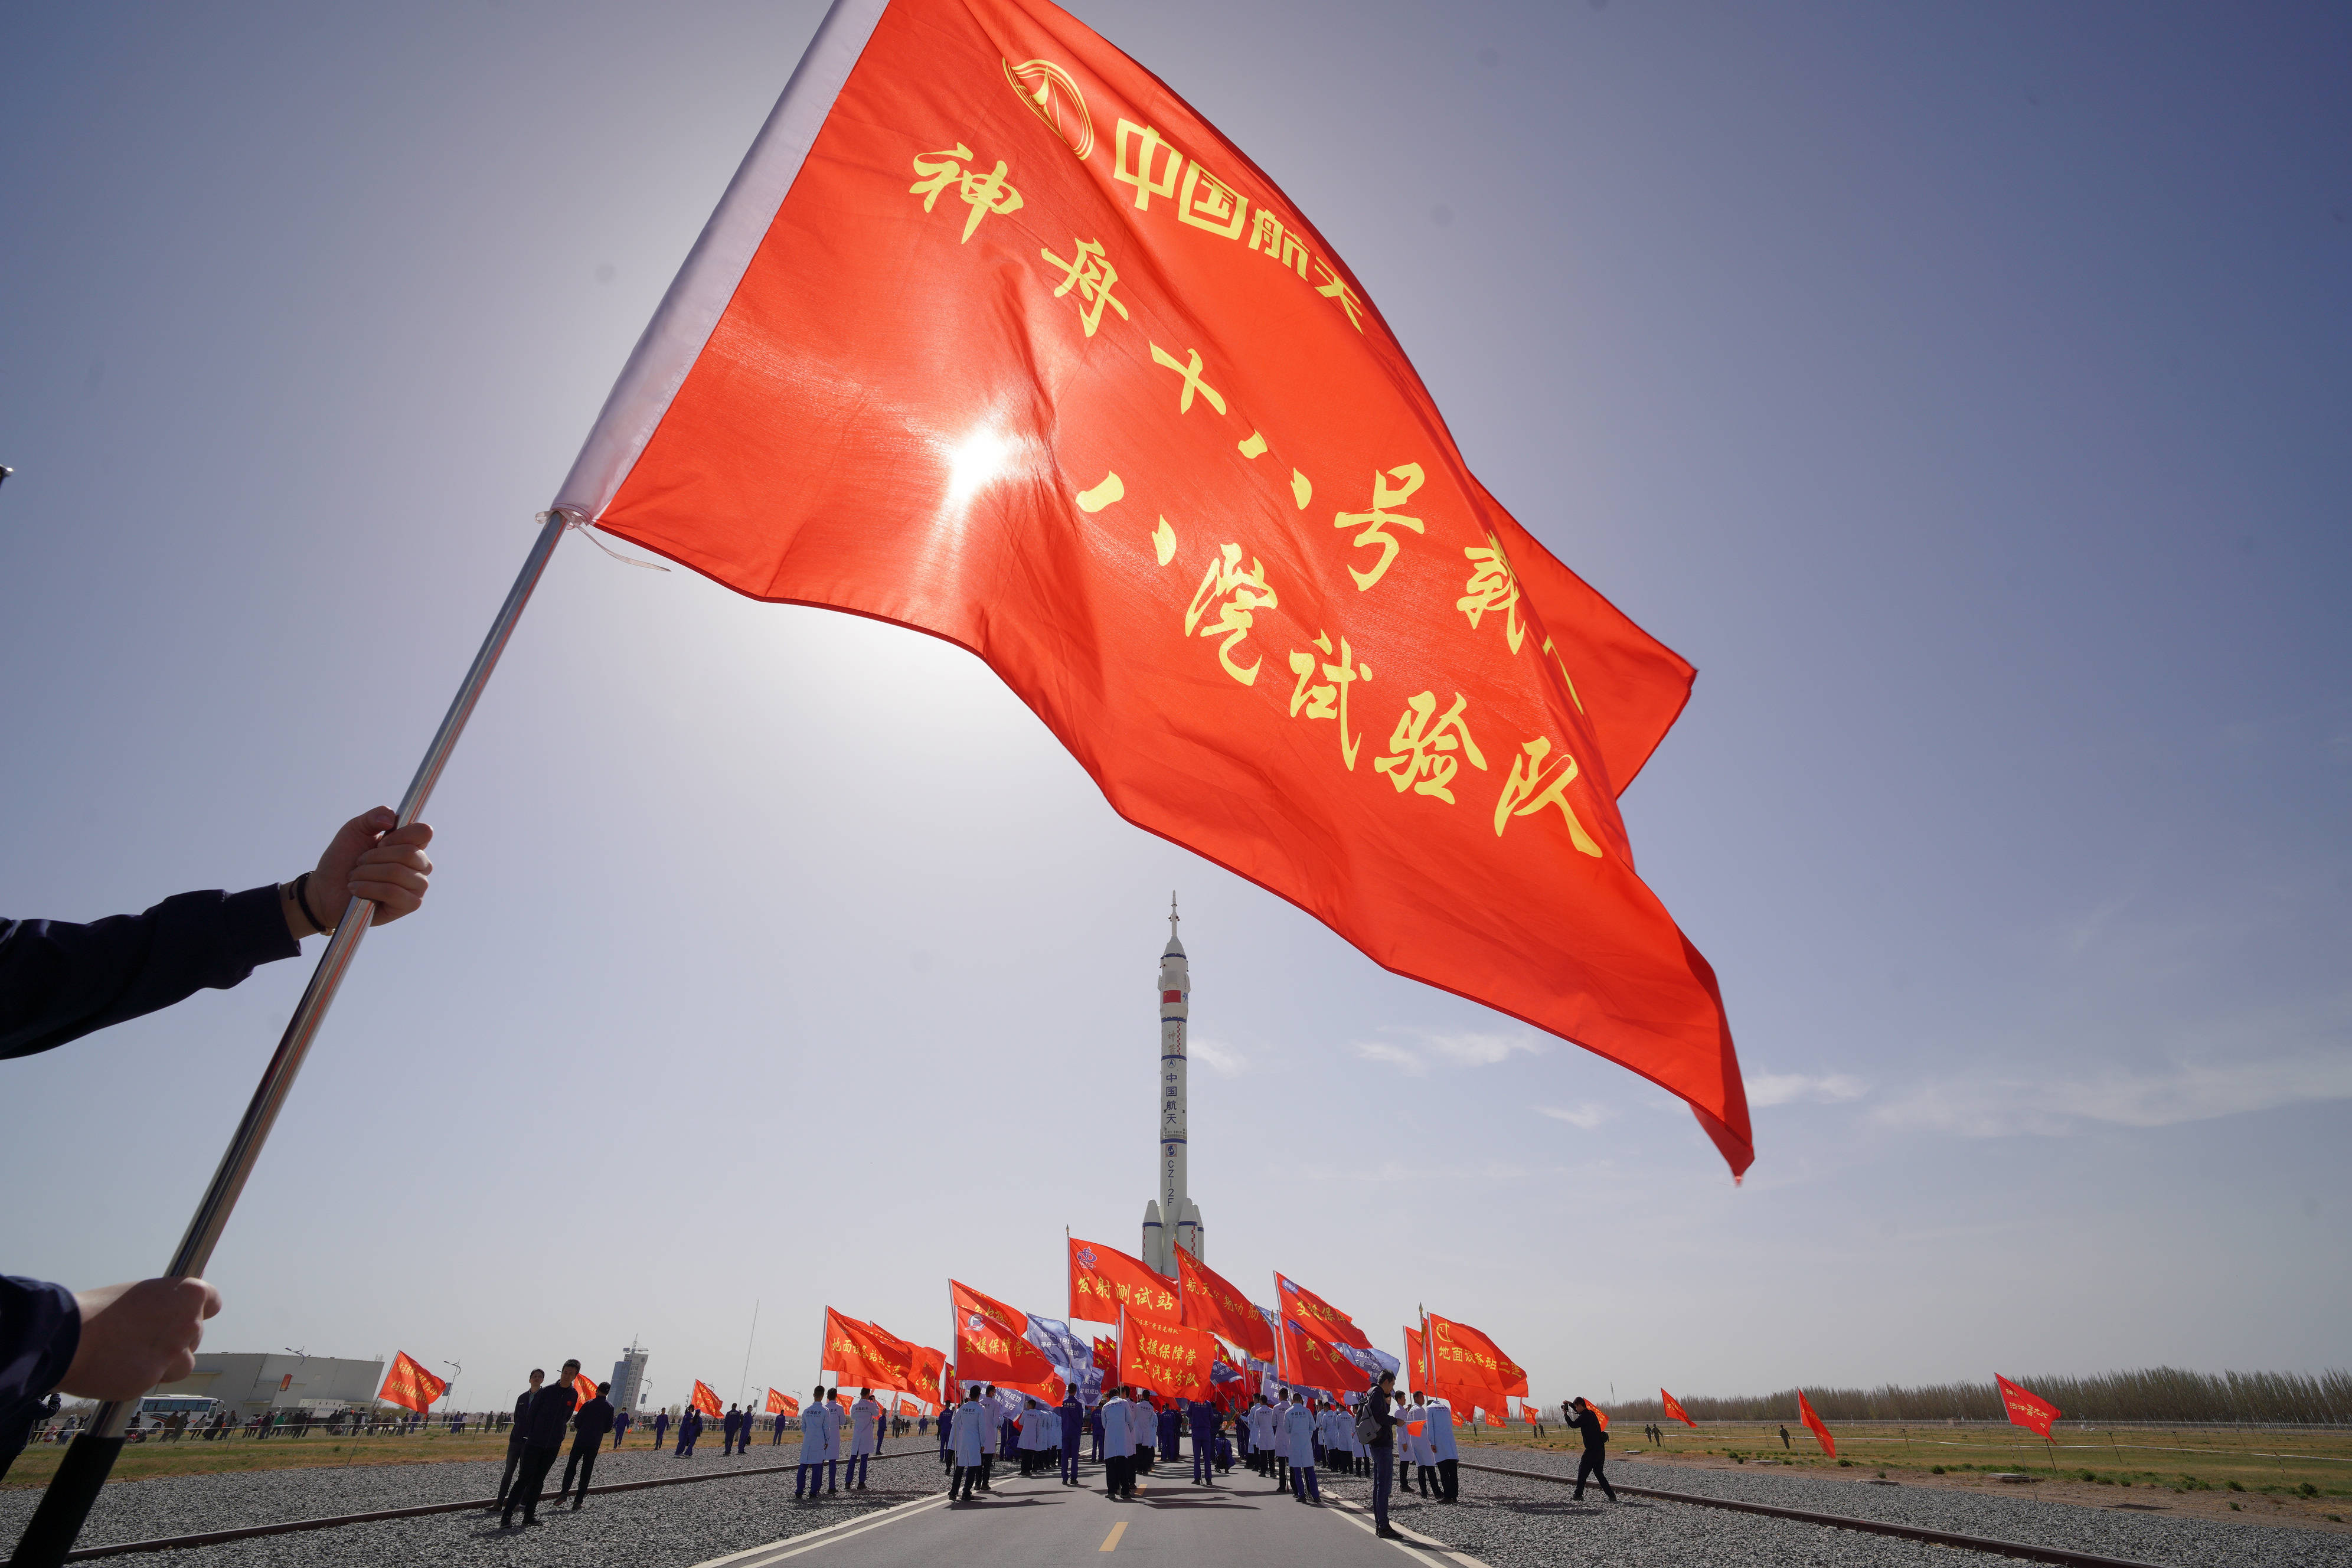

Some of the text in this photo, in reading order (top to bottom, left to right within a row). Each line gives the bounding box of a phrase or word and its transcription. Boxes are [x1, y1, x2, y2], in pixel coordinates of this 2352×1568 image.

[1113, 118, 1363, 334] 中国航天
[1076, 471, 1603, 858] 八院试验队
[1166, 1073, 1177, 1124] 中国航天
[1077, 1274, 1174, 1311] 发射测试站
[1138, 1334, 1197, 1366] 支援保障营
